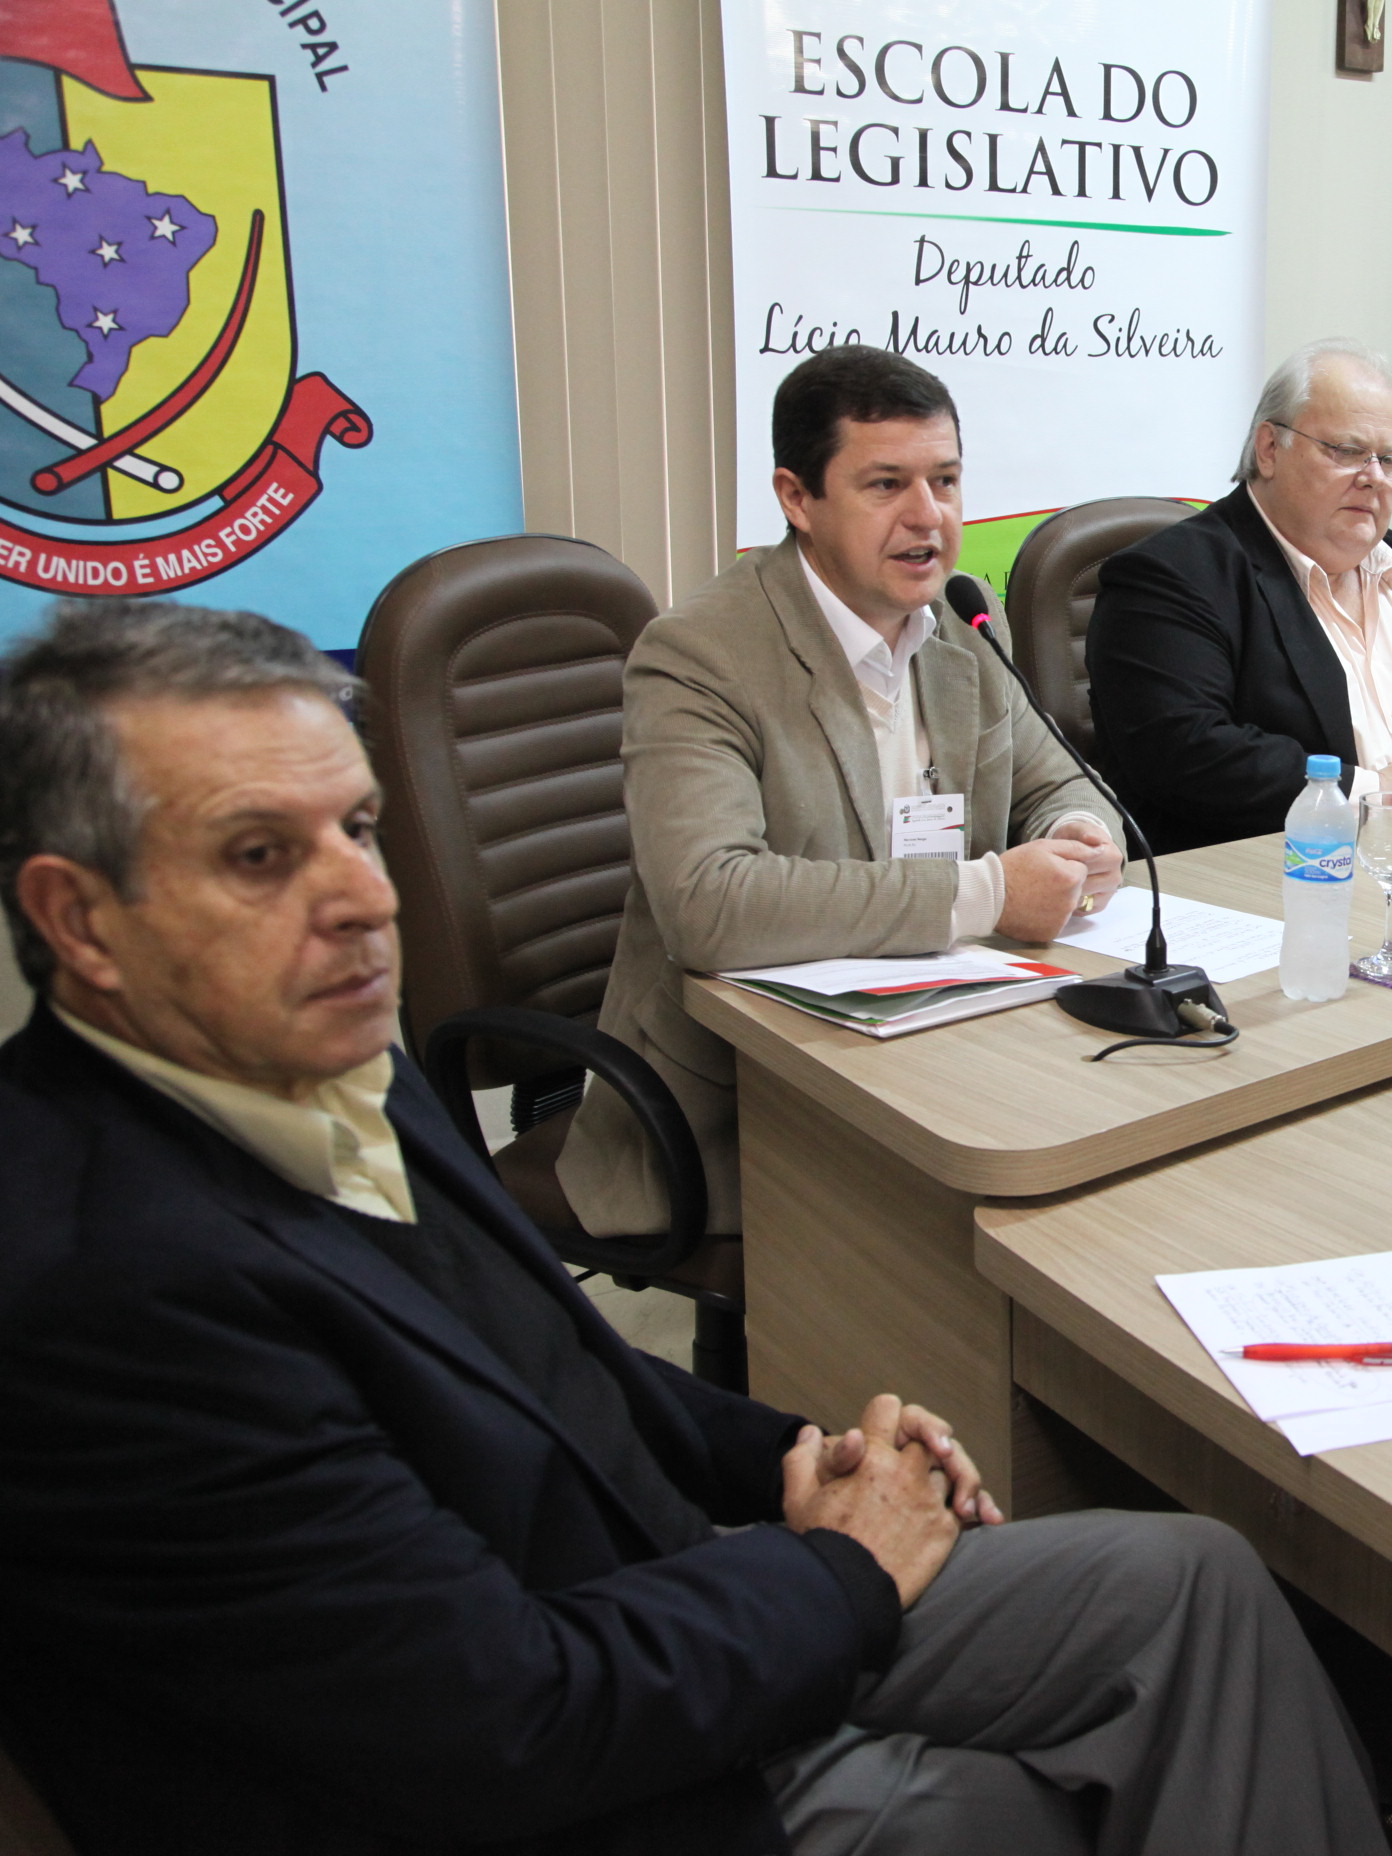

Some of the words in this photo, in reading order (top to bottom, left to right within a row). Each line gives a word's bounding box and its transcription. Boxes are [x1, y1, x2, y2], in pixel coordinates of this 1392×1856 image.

[267, 0, 349, 93] IPAL
[785, 28, 1080, 118] ESCOLA
[1097, 61, 1198, 128] DO
[758, 114, 1219, 206] LEGISLATIVO
[913, 234, 1096, 315] Deputado
[759, 302, 861, 354] Lício
[884, 309, 1013, 358] Mauro
[1028, 306, 1079, 357] da
[1087, 307, 1224, 359] Silveira
[36, 553, 128, 587] UNIDO
[133, 554, 155, 585] É
[155, 538, 224, 581] MAIS
[218, 481, 295, 552] FORTE
[1319, 856, 1353, 870] crysta
